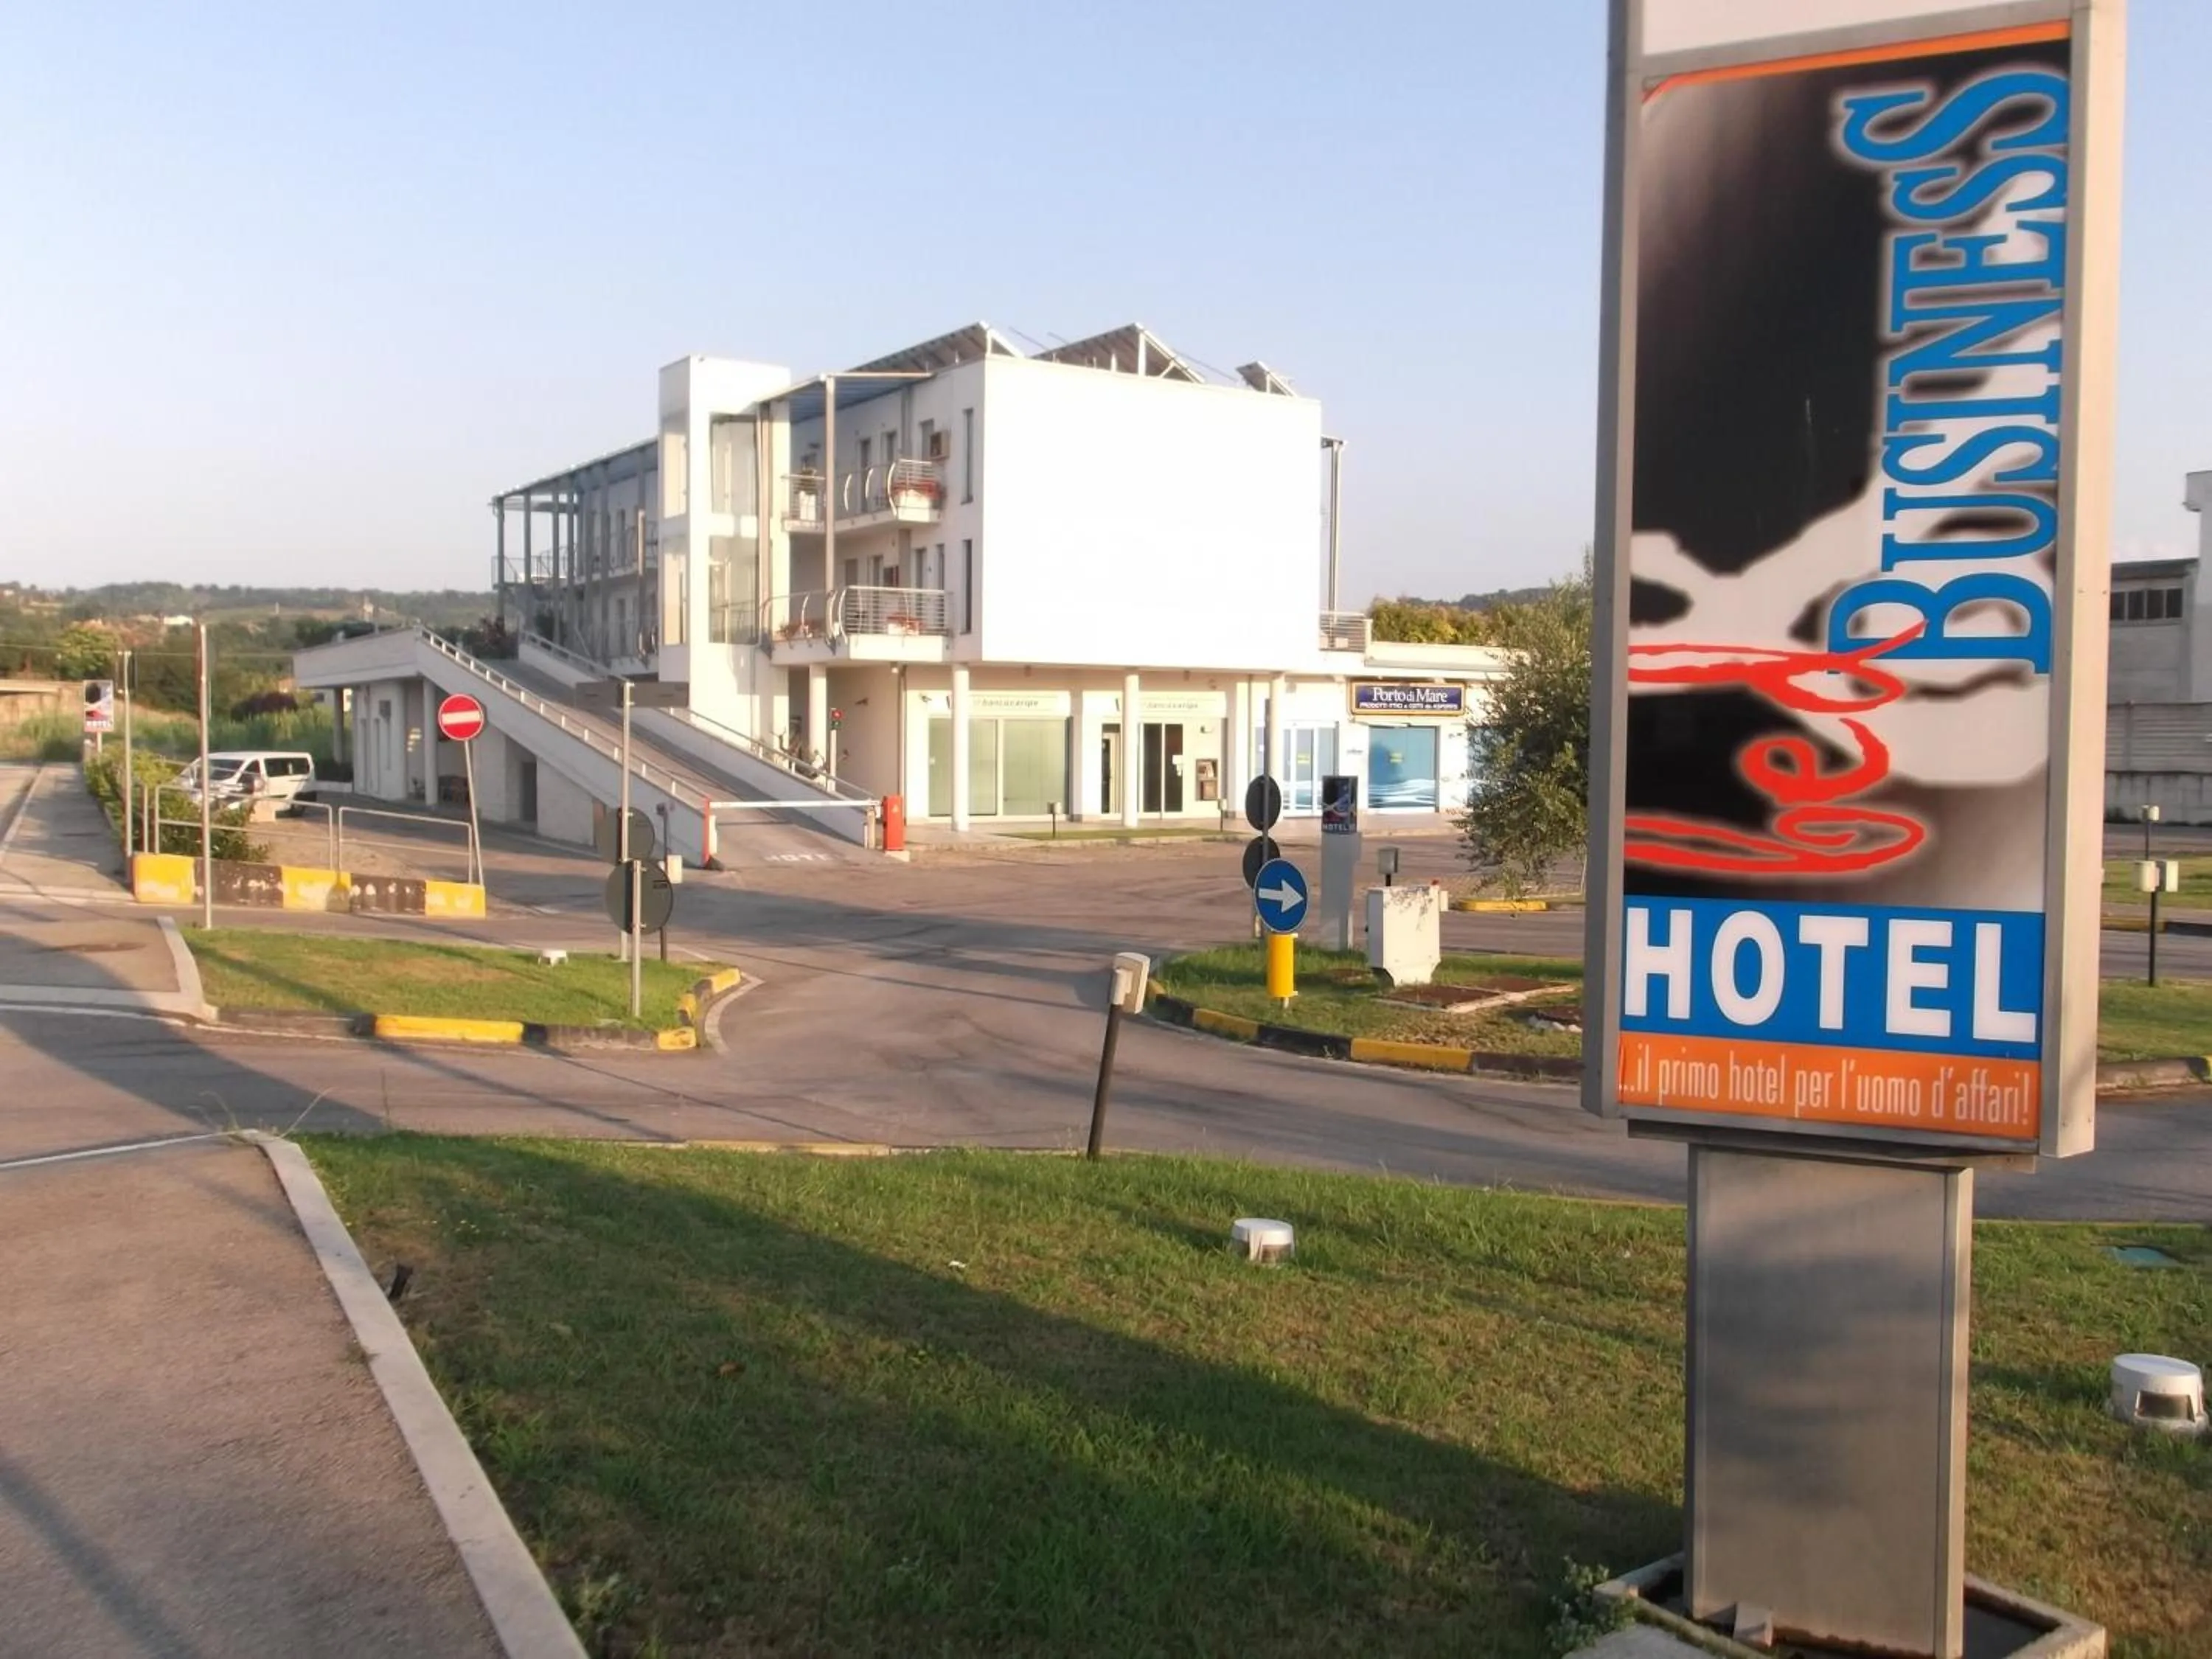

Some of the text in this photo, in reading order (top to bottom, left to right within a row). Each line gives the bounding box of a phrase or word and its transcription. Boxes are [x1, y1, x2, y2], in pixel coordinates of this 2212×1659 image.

[1827, 70, 2070, 674] BUSINESS
[1372, 686, 1405, 702] Porto
[1416, 688, 1448, 703] Mare
[1624, 906, 2037, 1043] HOTEL
[1658, 1046, 1719, 1107] primo
[1728, 1049, 1786, 1105] hotel
[1794, 1069, 1834, 1119] per
[1840, 1059, 1921, 1117] l'uomo
[1930, 1066, 2031, 1125] d'affari!
